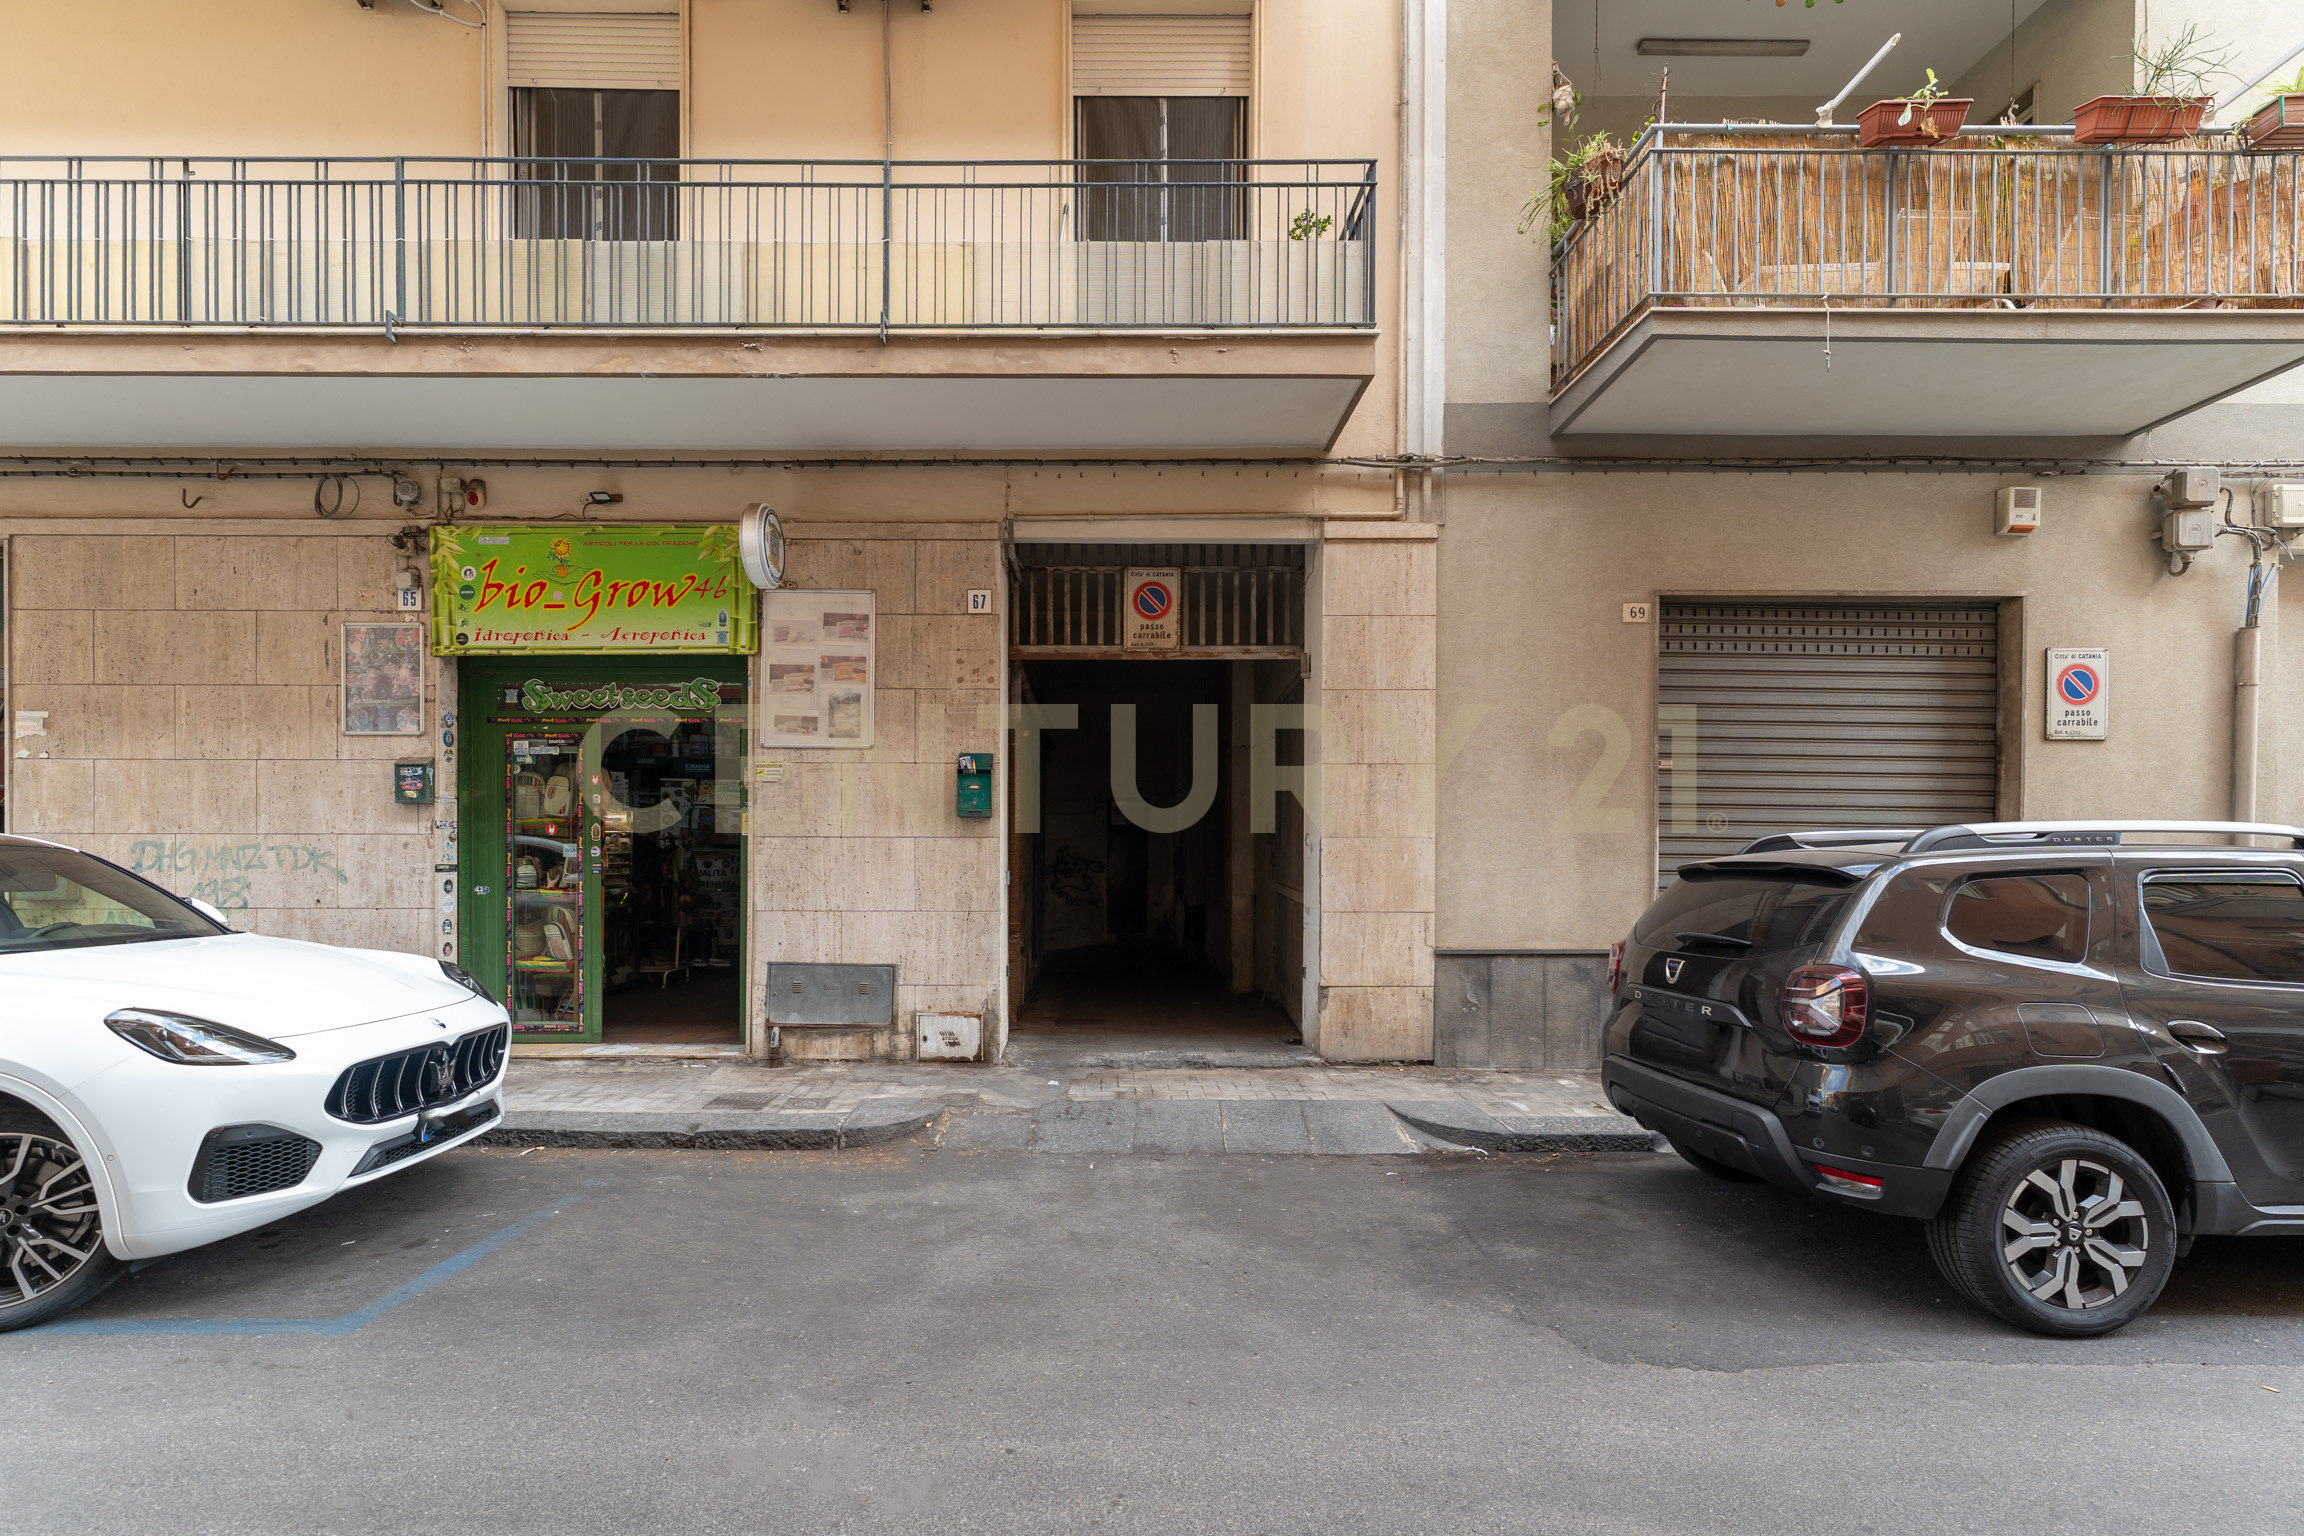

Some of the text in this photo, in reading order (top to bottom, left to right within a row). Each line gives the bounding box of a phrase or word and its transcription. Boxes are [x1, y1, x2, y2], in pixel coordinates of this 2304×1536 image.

[402, 591, 417, 607] 65
[972, 594, 987, 610] 67
[1630, 606, 1646, 619] 69
[1140, 623, 1165, 631] passo
[1132, 630, 1171, 639] carrabile
[2064, 709, 2091, 718] passo
[2057, 717, 2099, 726] carrabile
[696, 867, 727, 878] UALITÀ
[697, 880, 737, 889] REMIATA
[1634, 989, 1713, 1017] DUSTER
